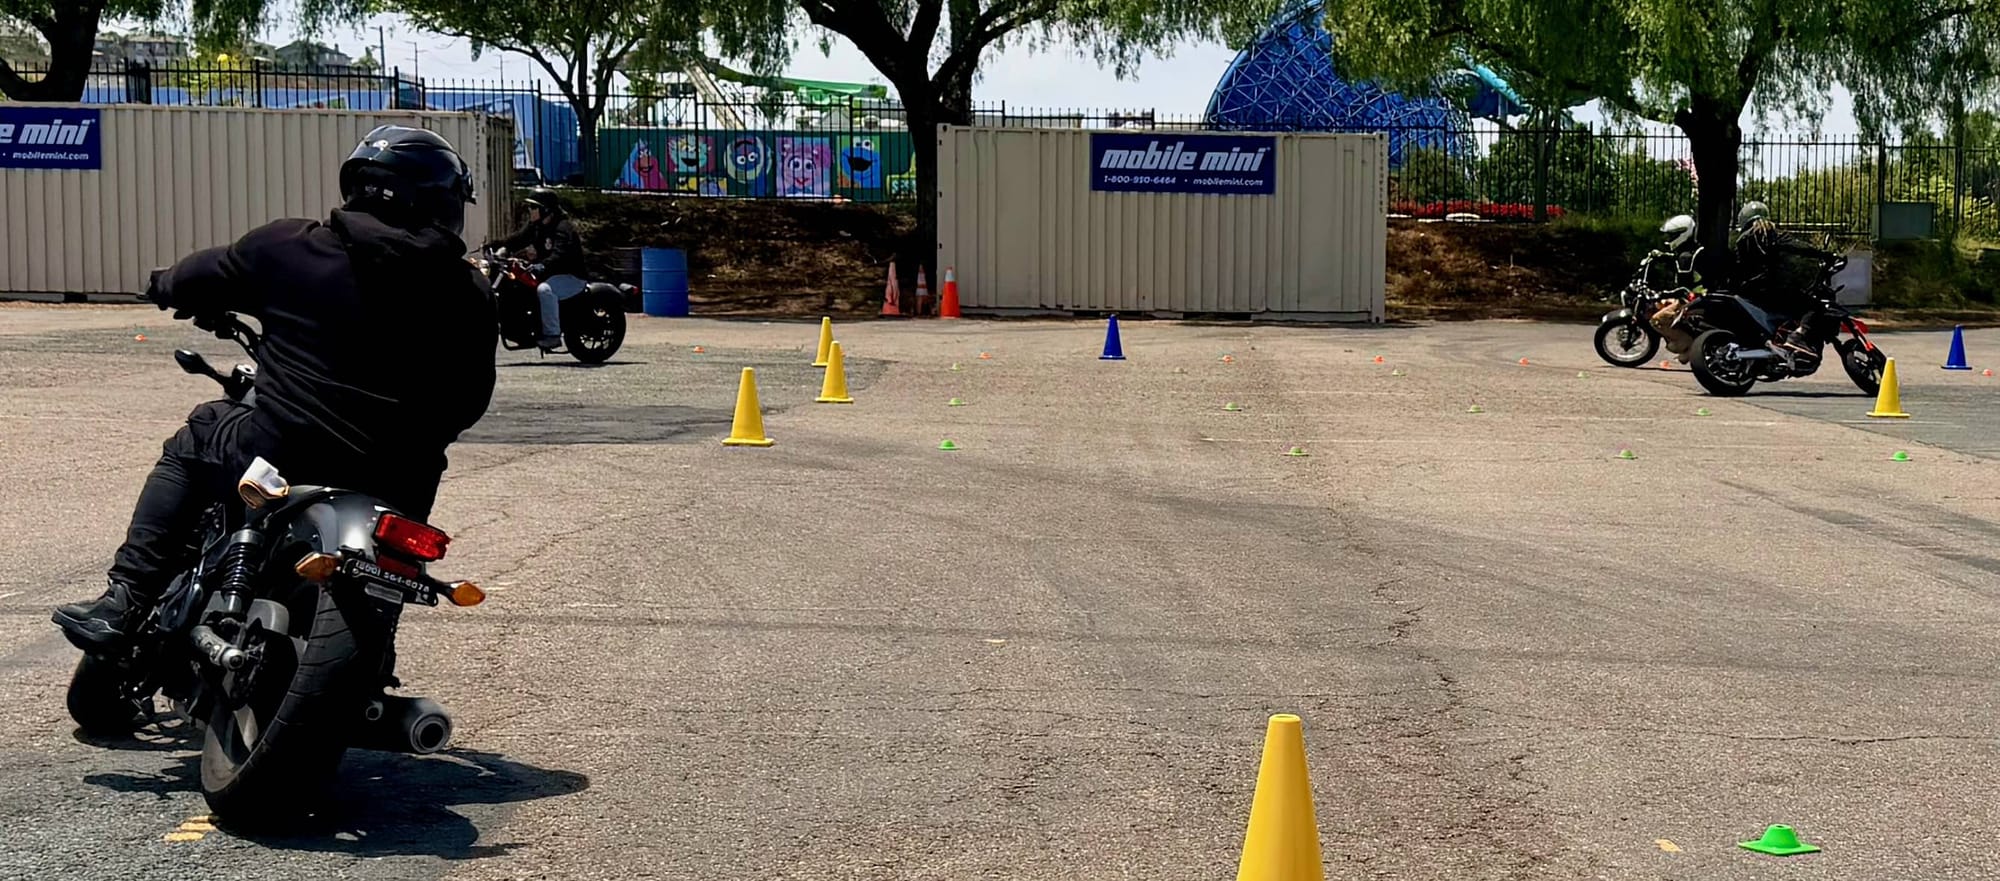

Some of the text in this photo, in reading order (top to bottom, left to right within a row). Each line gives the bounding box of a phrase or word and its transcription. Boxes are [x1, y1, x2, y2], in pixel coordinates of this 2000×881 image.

[18, 119, 91, 145] mini
[12, 151, 89, 160] mobilemini.com
[1100, 141, 1266, 171] mobile mini
[1193, 177, 1263, 186] mobilemini.com
